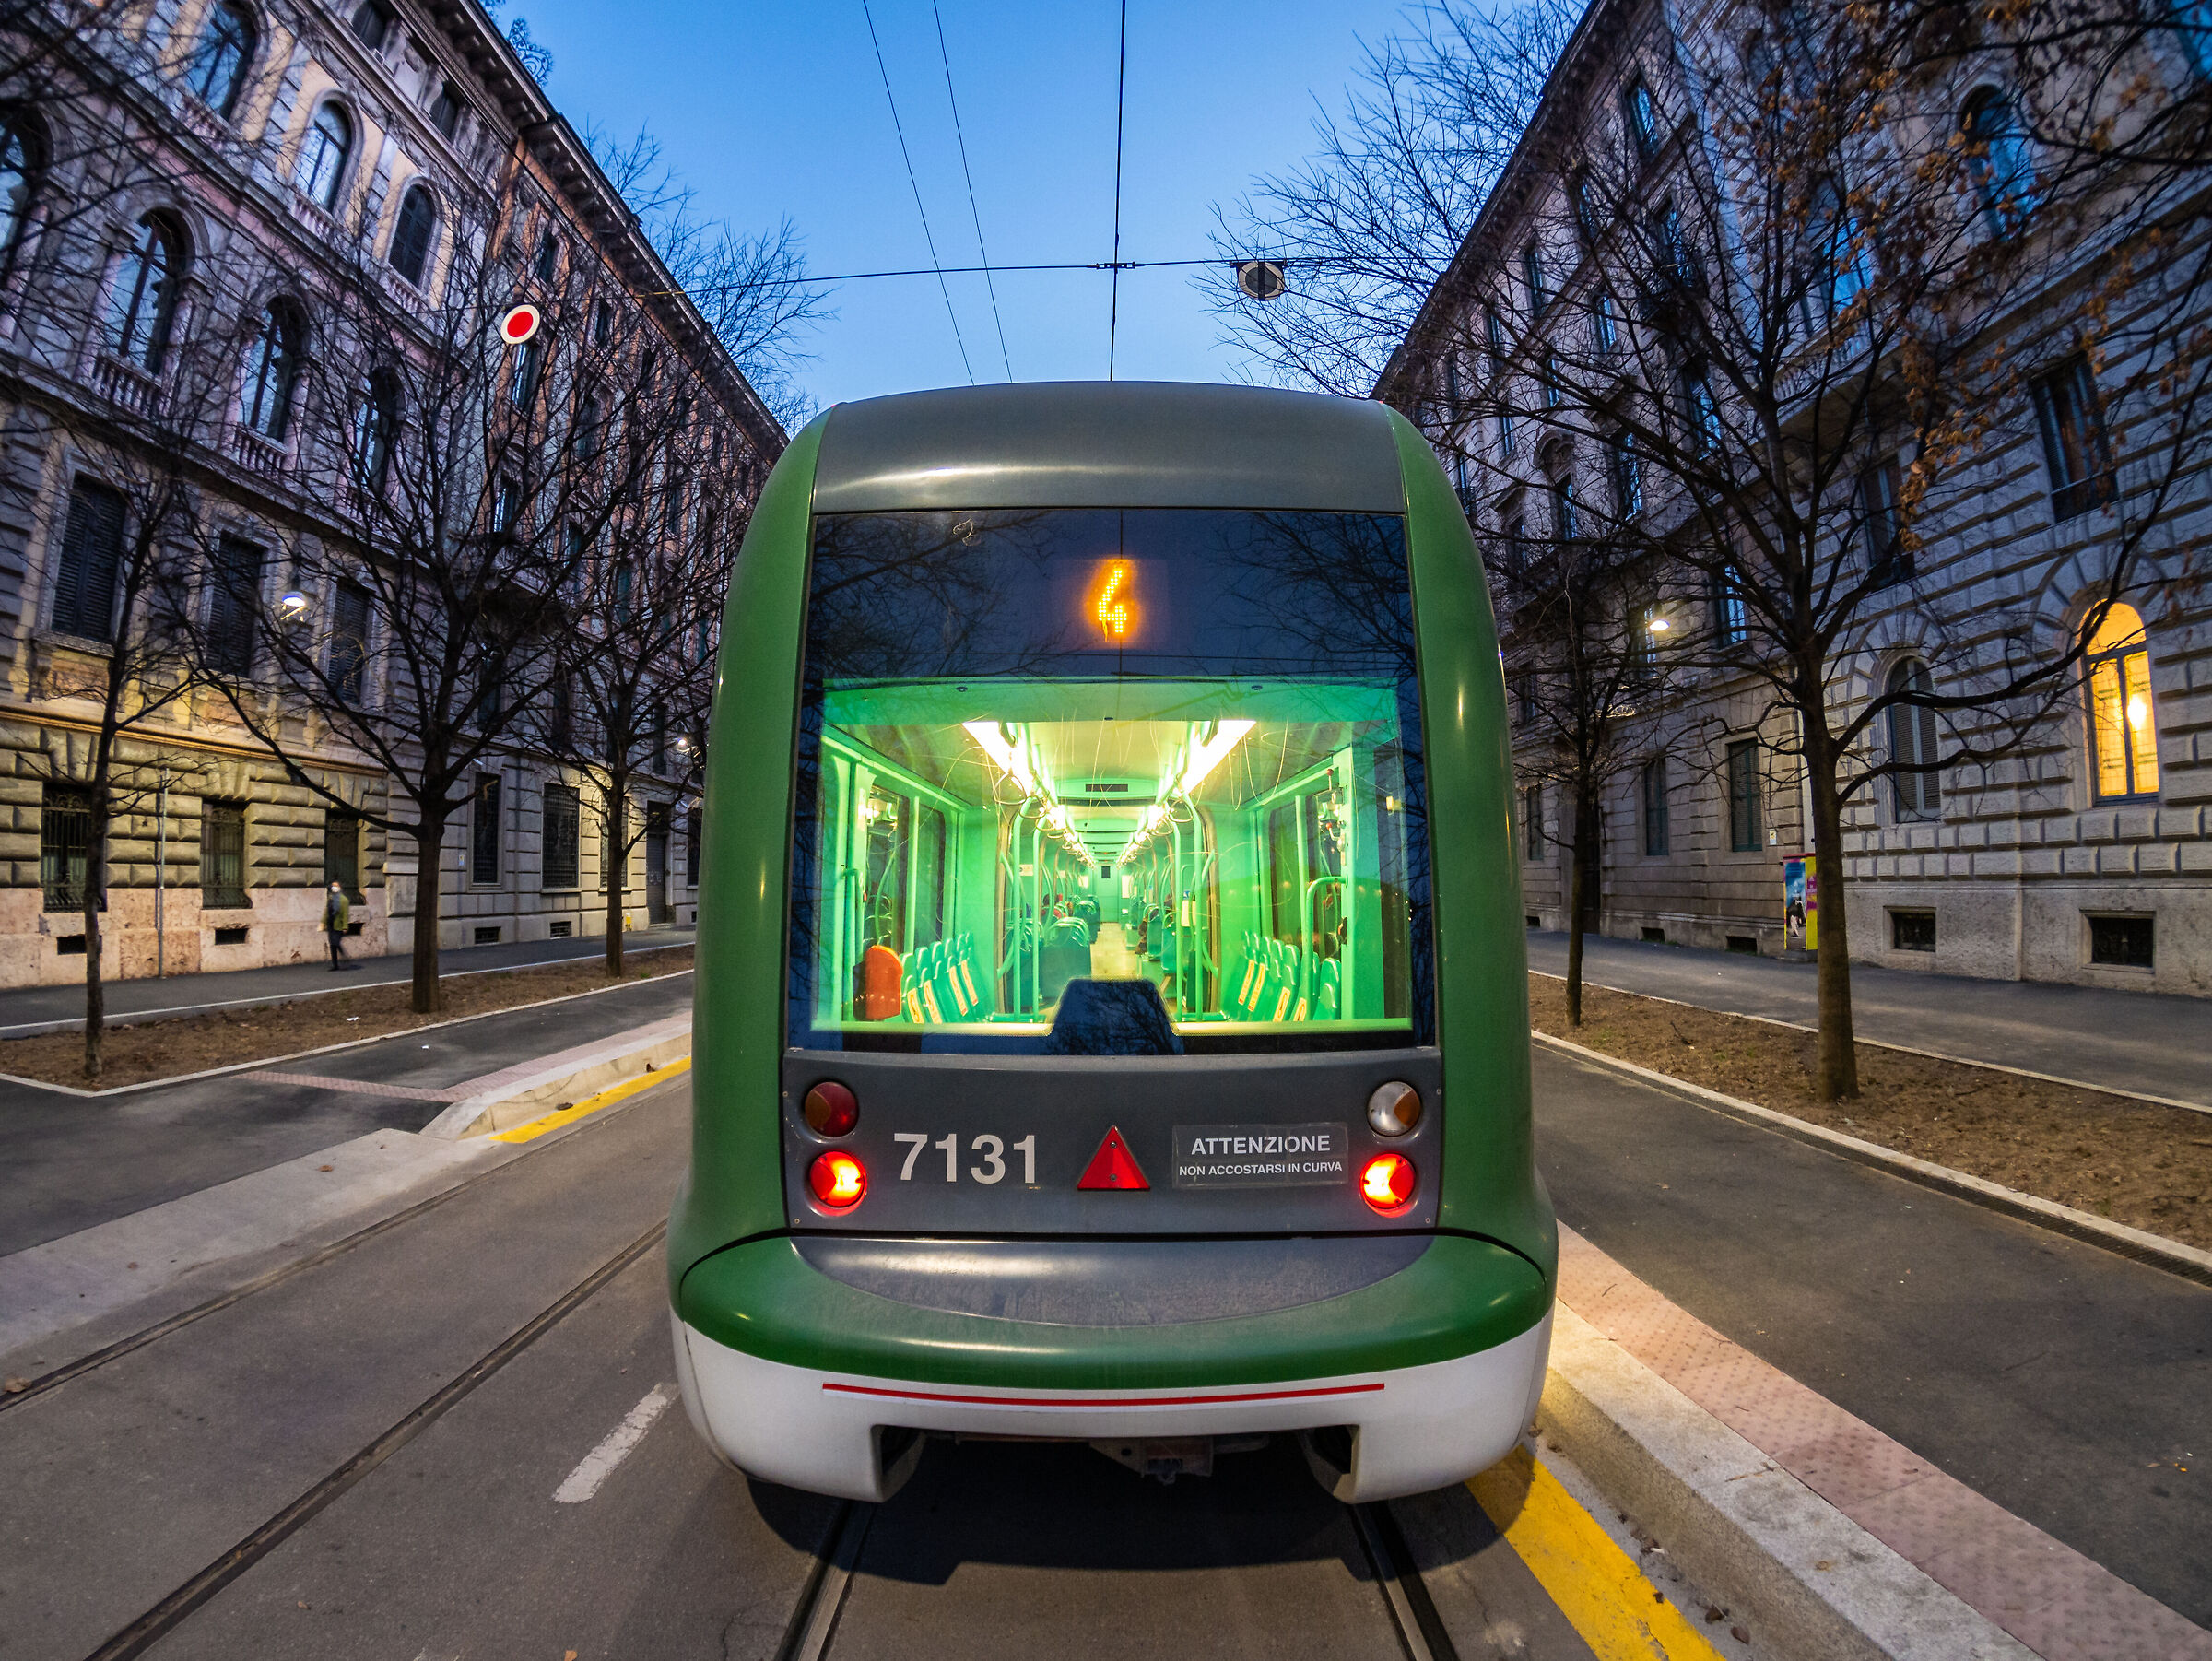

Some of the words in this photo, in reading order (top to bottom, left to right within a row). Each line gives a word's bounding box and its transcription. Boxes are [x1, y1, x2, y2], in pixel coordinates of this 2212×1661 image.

[1098, 569, 1127, 634] 4
[894, 1133, 1035, 1184] 7131
[1191, 1135, 1331, 1155] ATTENZIONE
[1179, 1165, 1206, 1176] NON
[1208, 1164, 1286, 1175] ACCOSTARSI
[1288, 1162, 1300, 1173] IN
[1302, 1161, 1343, 1172] CURVA
